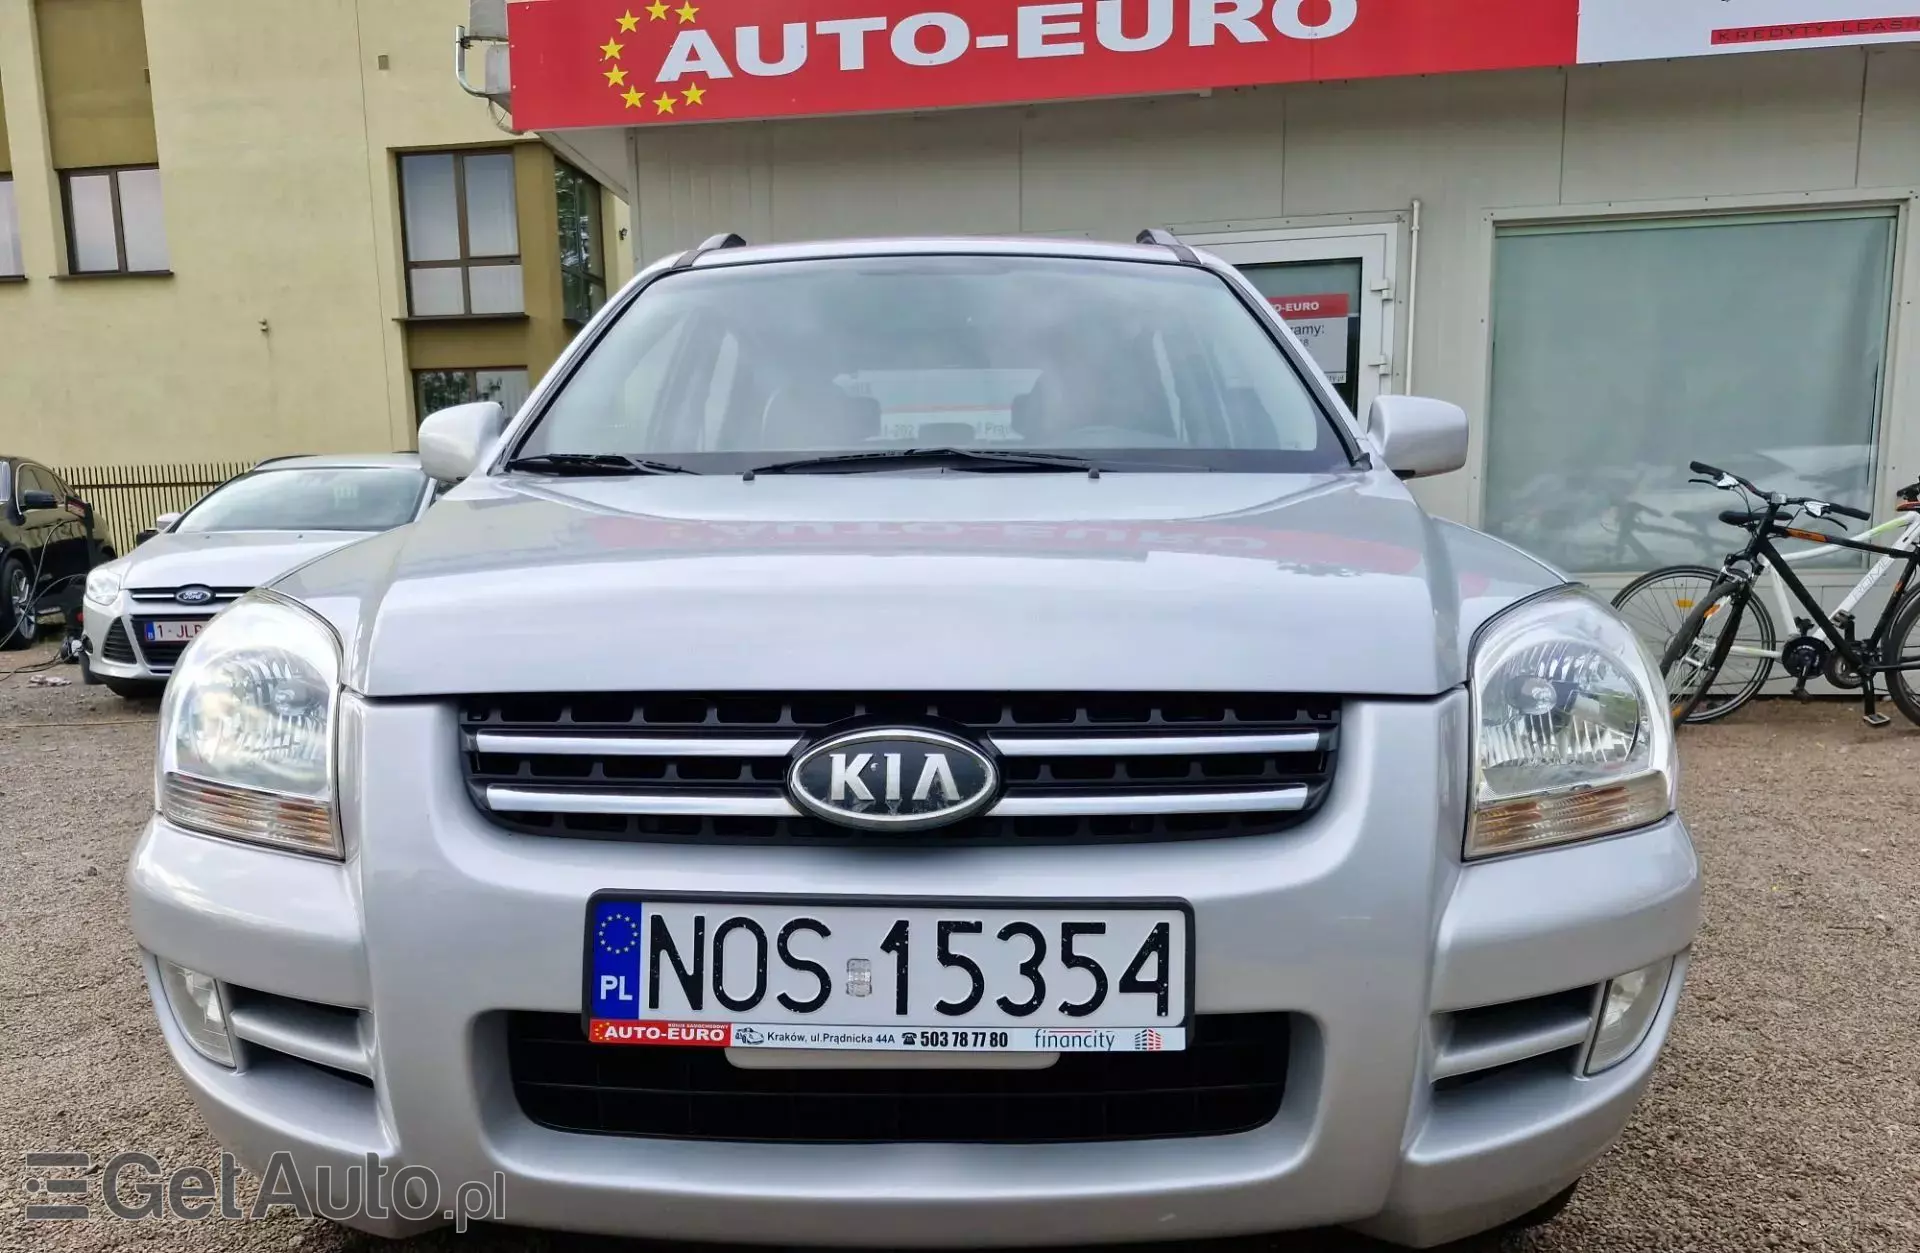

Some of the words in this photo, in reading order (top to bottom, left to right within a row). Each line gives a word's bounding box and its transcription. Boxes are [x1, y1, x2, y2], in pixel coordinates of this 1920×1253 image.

[654, 0, 1358, 83] AUTO-EURO
[1718, 25, 1825, 42] KREDYTY
[1271, 301, 1320, 312] O-EURO
[182, 591, 203, 600] Ford
[829, 753, 960, 801] KIA
[600, 975, 633, 1001] PL
[648, 914, 832, 1014] NOS
[880, 919, 1170, 1017] 15354
[603, 1025, 725, 1042] AUTO-EURO
[767, 1031, 807, 1043] Kraków,
[875, 1034, 896, 1044] 44A
[920, 1031, 949, 1048] 503
[952, 1031, 969, 1048] 78
[971, 1031, 987, 1048] 77
[989, 1031, 1009, 1048] 80
[1034, 1028, 1116, 1051] financity
